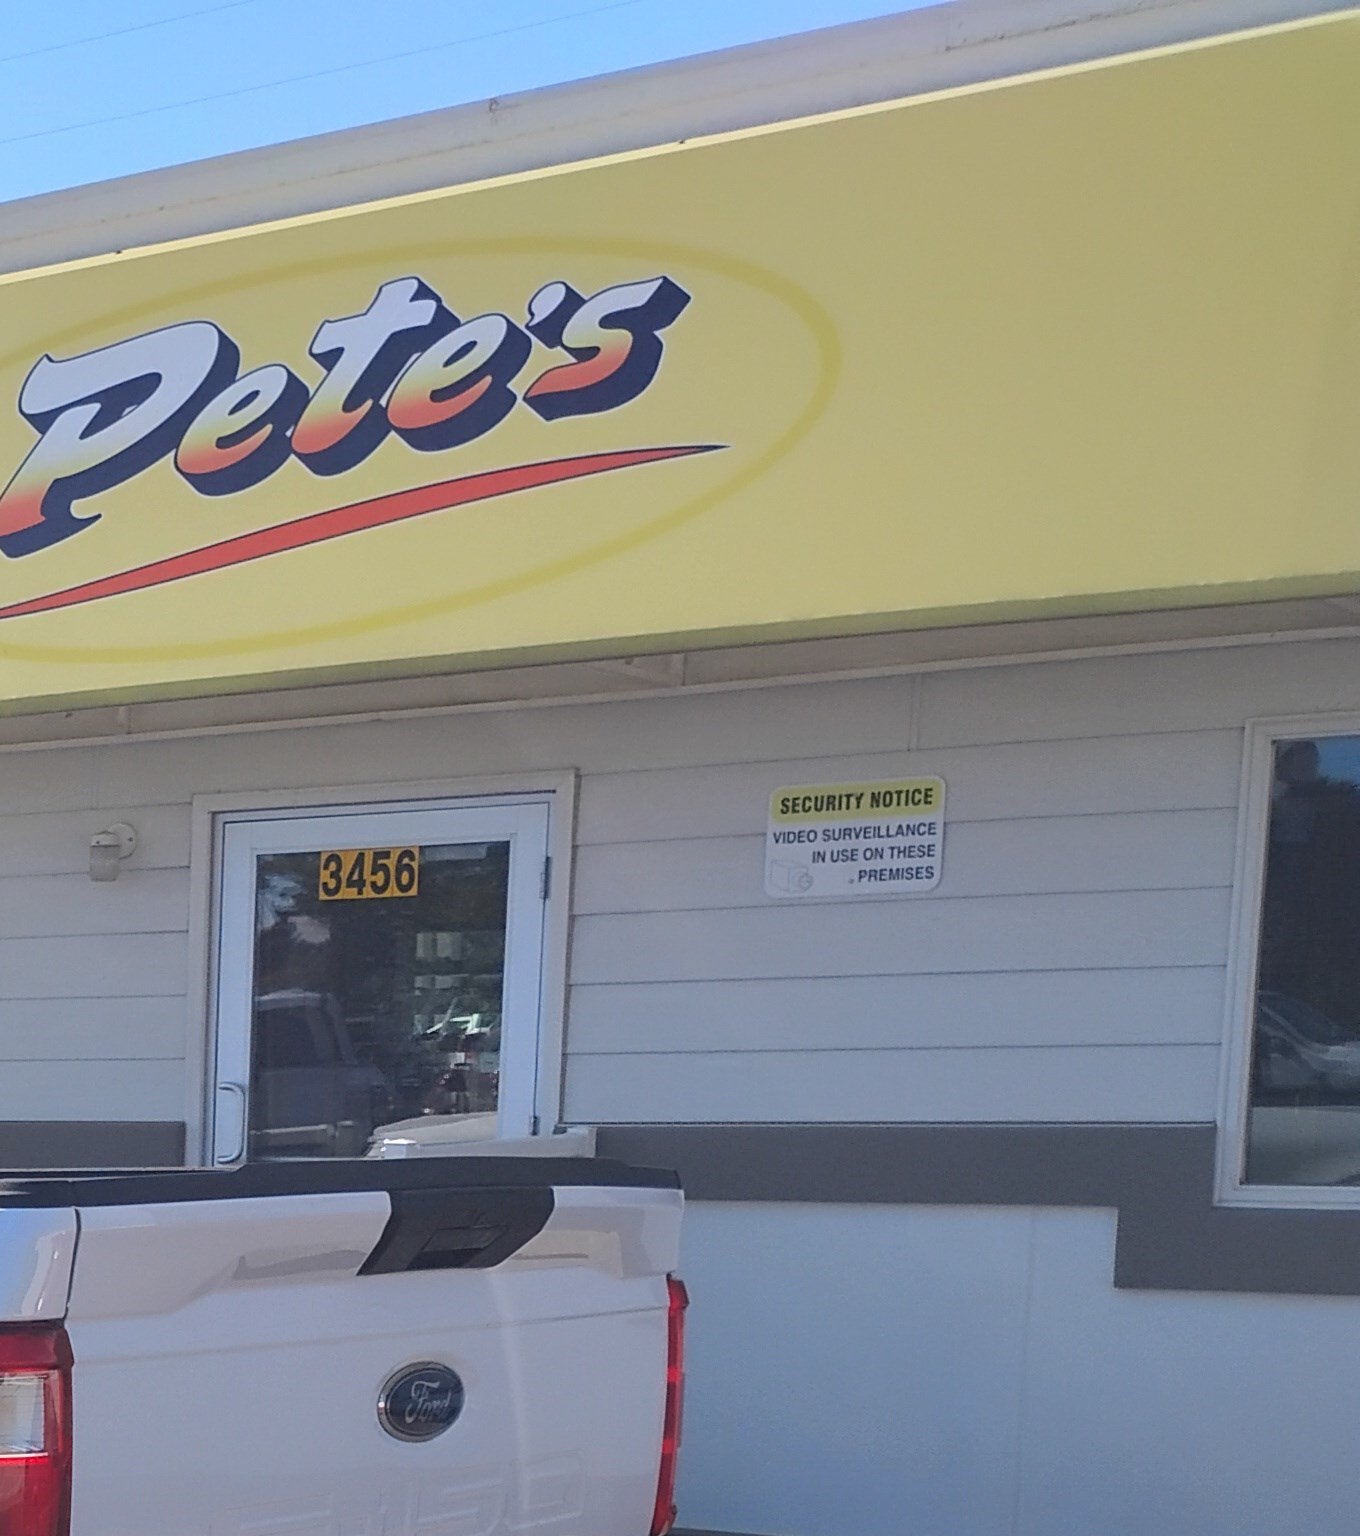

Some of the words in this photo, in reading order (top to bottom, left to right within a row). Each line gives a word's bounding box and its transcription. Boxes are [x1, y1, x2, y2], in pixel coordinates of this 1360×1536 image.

[781, 793, 864, 814] SECURITY
[870, 788, 933, 808] NOTICE
[773, 830, 817, 844] VIDEO
[822, 822, 936, 842] SURVEILLANCE
[812, 851, 825, 863] IN
[830, 849, 858, 863] USE
[863, 847, 883, 861] ON
[889, 845, 935, 859] THESE
[321, 849, 417, 896] 3456
[858, 866, 934, 883] PREMISES
[405, 1380, 451, 1424] Ford
